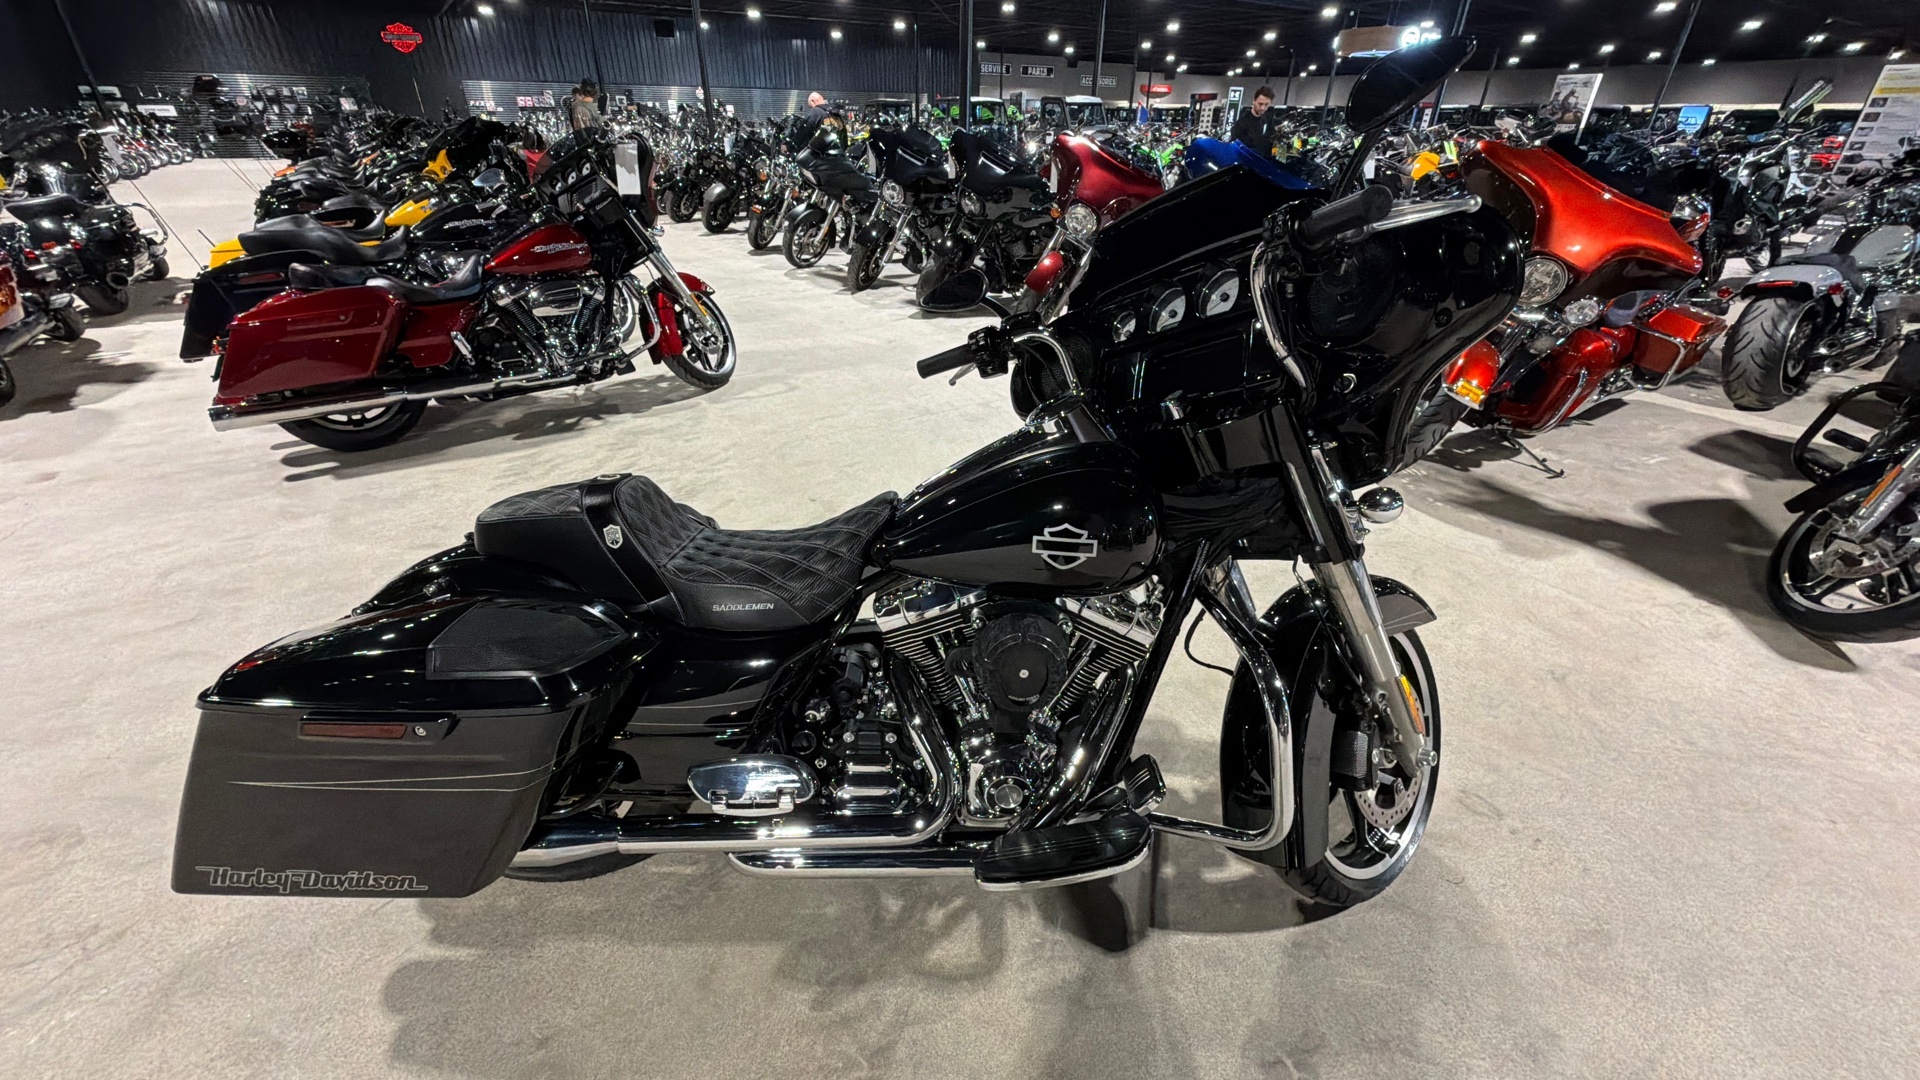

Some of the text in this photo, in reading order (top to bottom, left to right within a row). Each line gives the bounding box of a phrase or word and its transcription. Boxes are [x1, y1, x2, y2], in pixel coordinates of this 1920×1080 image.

[1028, 67, 1047, 75] PARTS
[1082, 77, 1116, 86] ACCSORIES
[712, 603, 774, 612] SADDLEMEN
[195, 865, 428, 894] Harley-Davidson
